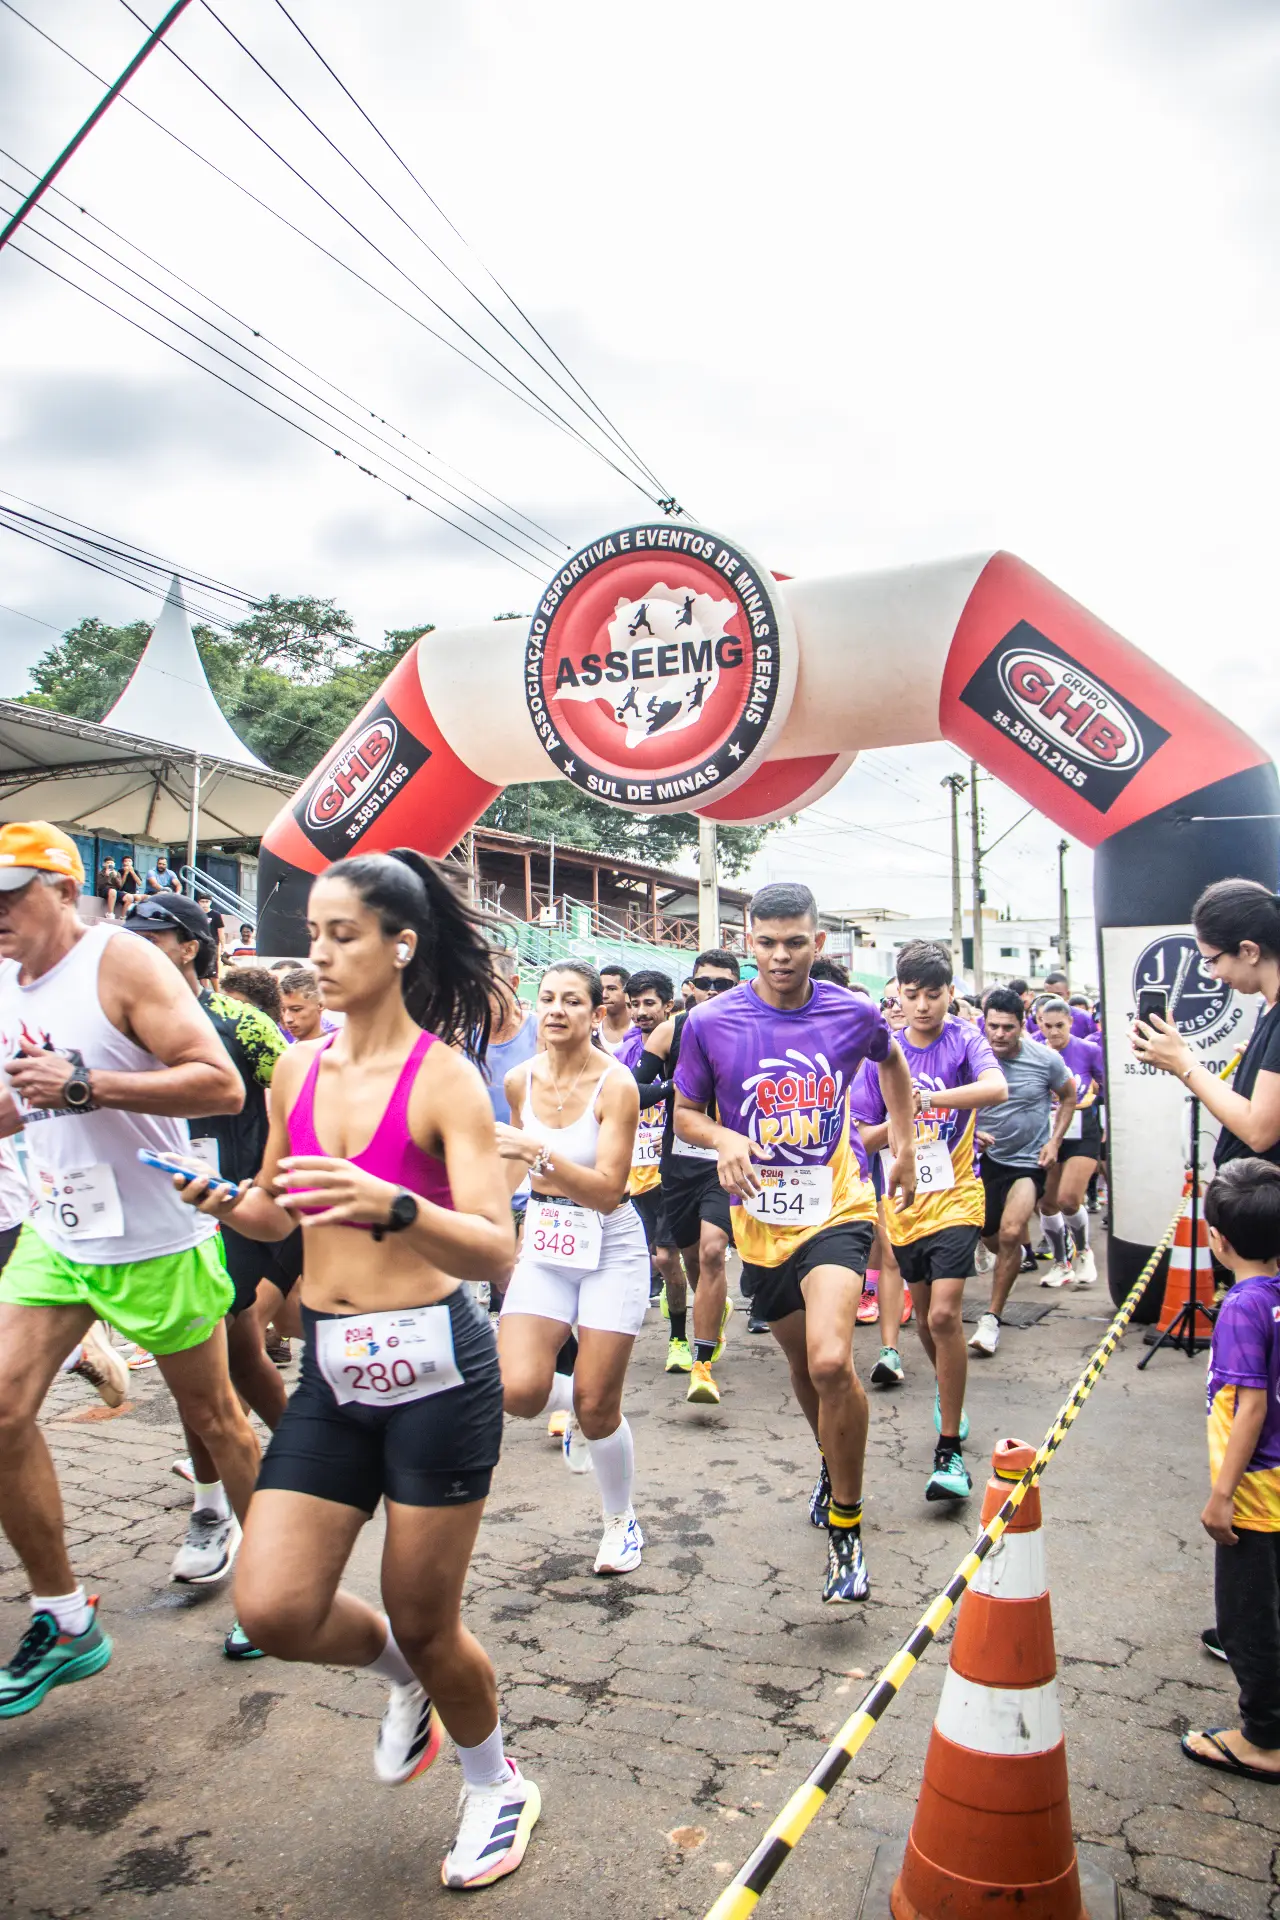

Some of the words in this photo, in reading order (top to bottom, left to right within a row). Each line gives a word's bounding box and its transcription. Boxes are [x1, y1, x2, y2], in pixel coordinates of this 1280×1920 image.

[620, 533, 631, 551] E
[635, 529, 716, 559] EVENTOS
[714, 549, 741, 577] DE
[541, 541, 616, 616] ESPORTIVA
[734, 573, 769, 639] MINAS
[555, 635, 744, 690] ASSEEMG
[526, 619, 560, 751] ASSOCIAÇÃO
[745, 644, 772, 726] GERAIS
[1062, 672, 1108, 710] GRUPO
[1007, 660, 1127, 763] GHB
[328, 744, 357, 780] GRUPO
[992, 709, 1088, 787] 35.3851.2165
[314, 729, 391, 820] GHB
[587, 774, 621, 799] SUL
[627, 785, 653, 801] DE
[657, 764, 720, 800] MINAS
[345, 763, 410, 839] 35.3851.2165
[1196, 1007, 1244, 1050] VAREJO
[756, 1191, 805, 1215] 154
[533, 1229, 576, 1256] 348
[342, 1359, 417, 1393] 280
